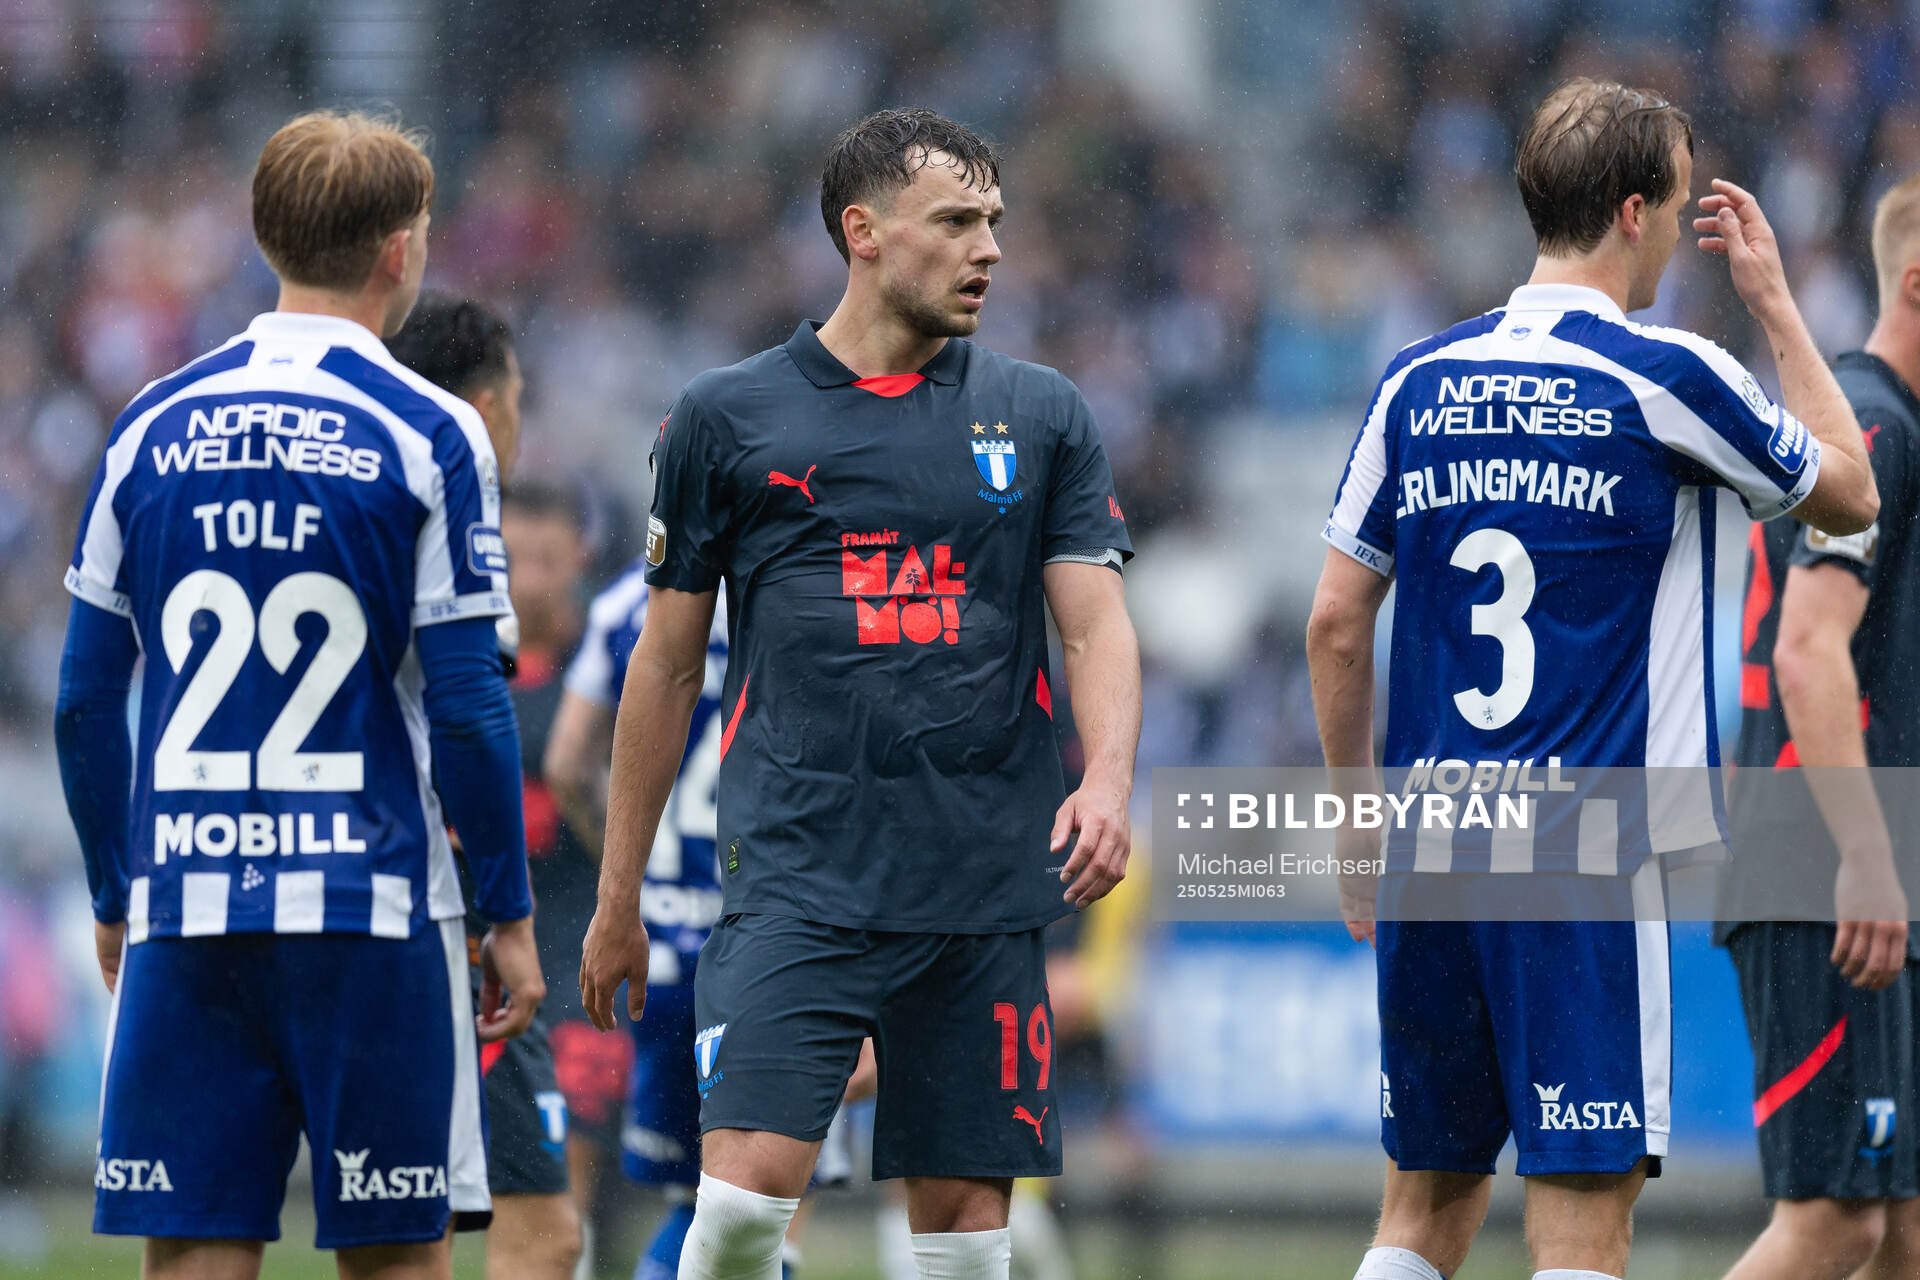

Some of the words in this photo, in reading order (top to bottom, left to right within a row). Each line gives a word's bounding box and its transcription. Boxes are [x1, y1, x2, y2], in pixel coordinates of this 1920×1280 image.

[1437, 375, 1577, 406] NORDIC
[186, 402, 347, 442] NORDIC
[1409, 405, 1613, 437] WELLNESS
[152, 435, 382, 482] WELLNESS
[977, 488, 1012, 504] Malmö
[1012, 489, 1023, 502] FF
[1779, 487, 1806, 510] IFK
[193, 499, 323, 553] TOLF
[841, 527, 900, 547] FRAMÅT
[1353, 544, 1382, 568] IFK
[1449, 528, 1536, 731] 3
[154, 568, 367, 792] 22
[1402, 755, 1577, 798] MOBILL
[154, 812, 367, 866] MOBILL
[994, 1003, 1052, 1090] 19
[1539, 1101, 1642, 1130] RASTA
[339, 1165, 449, 1201] RASTA
